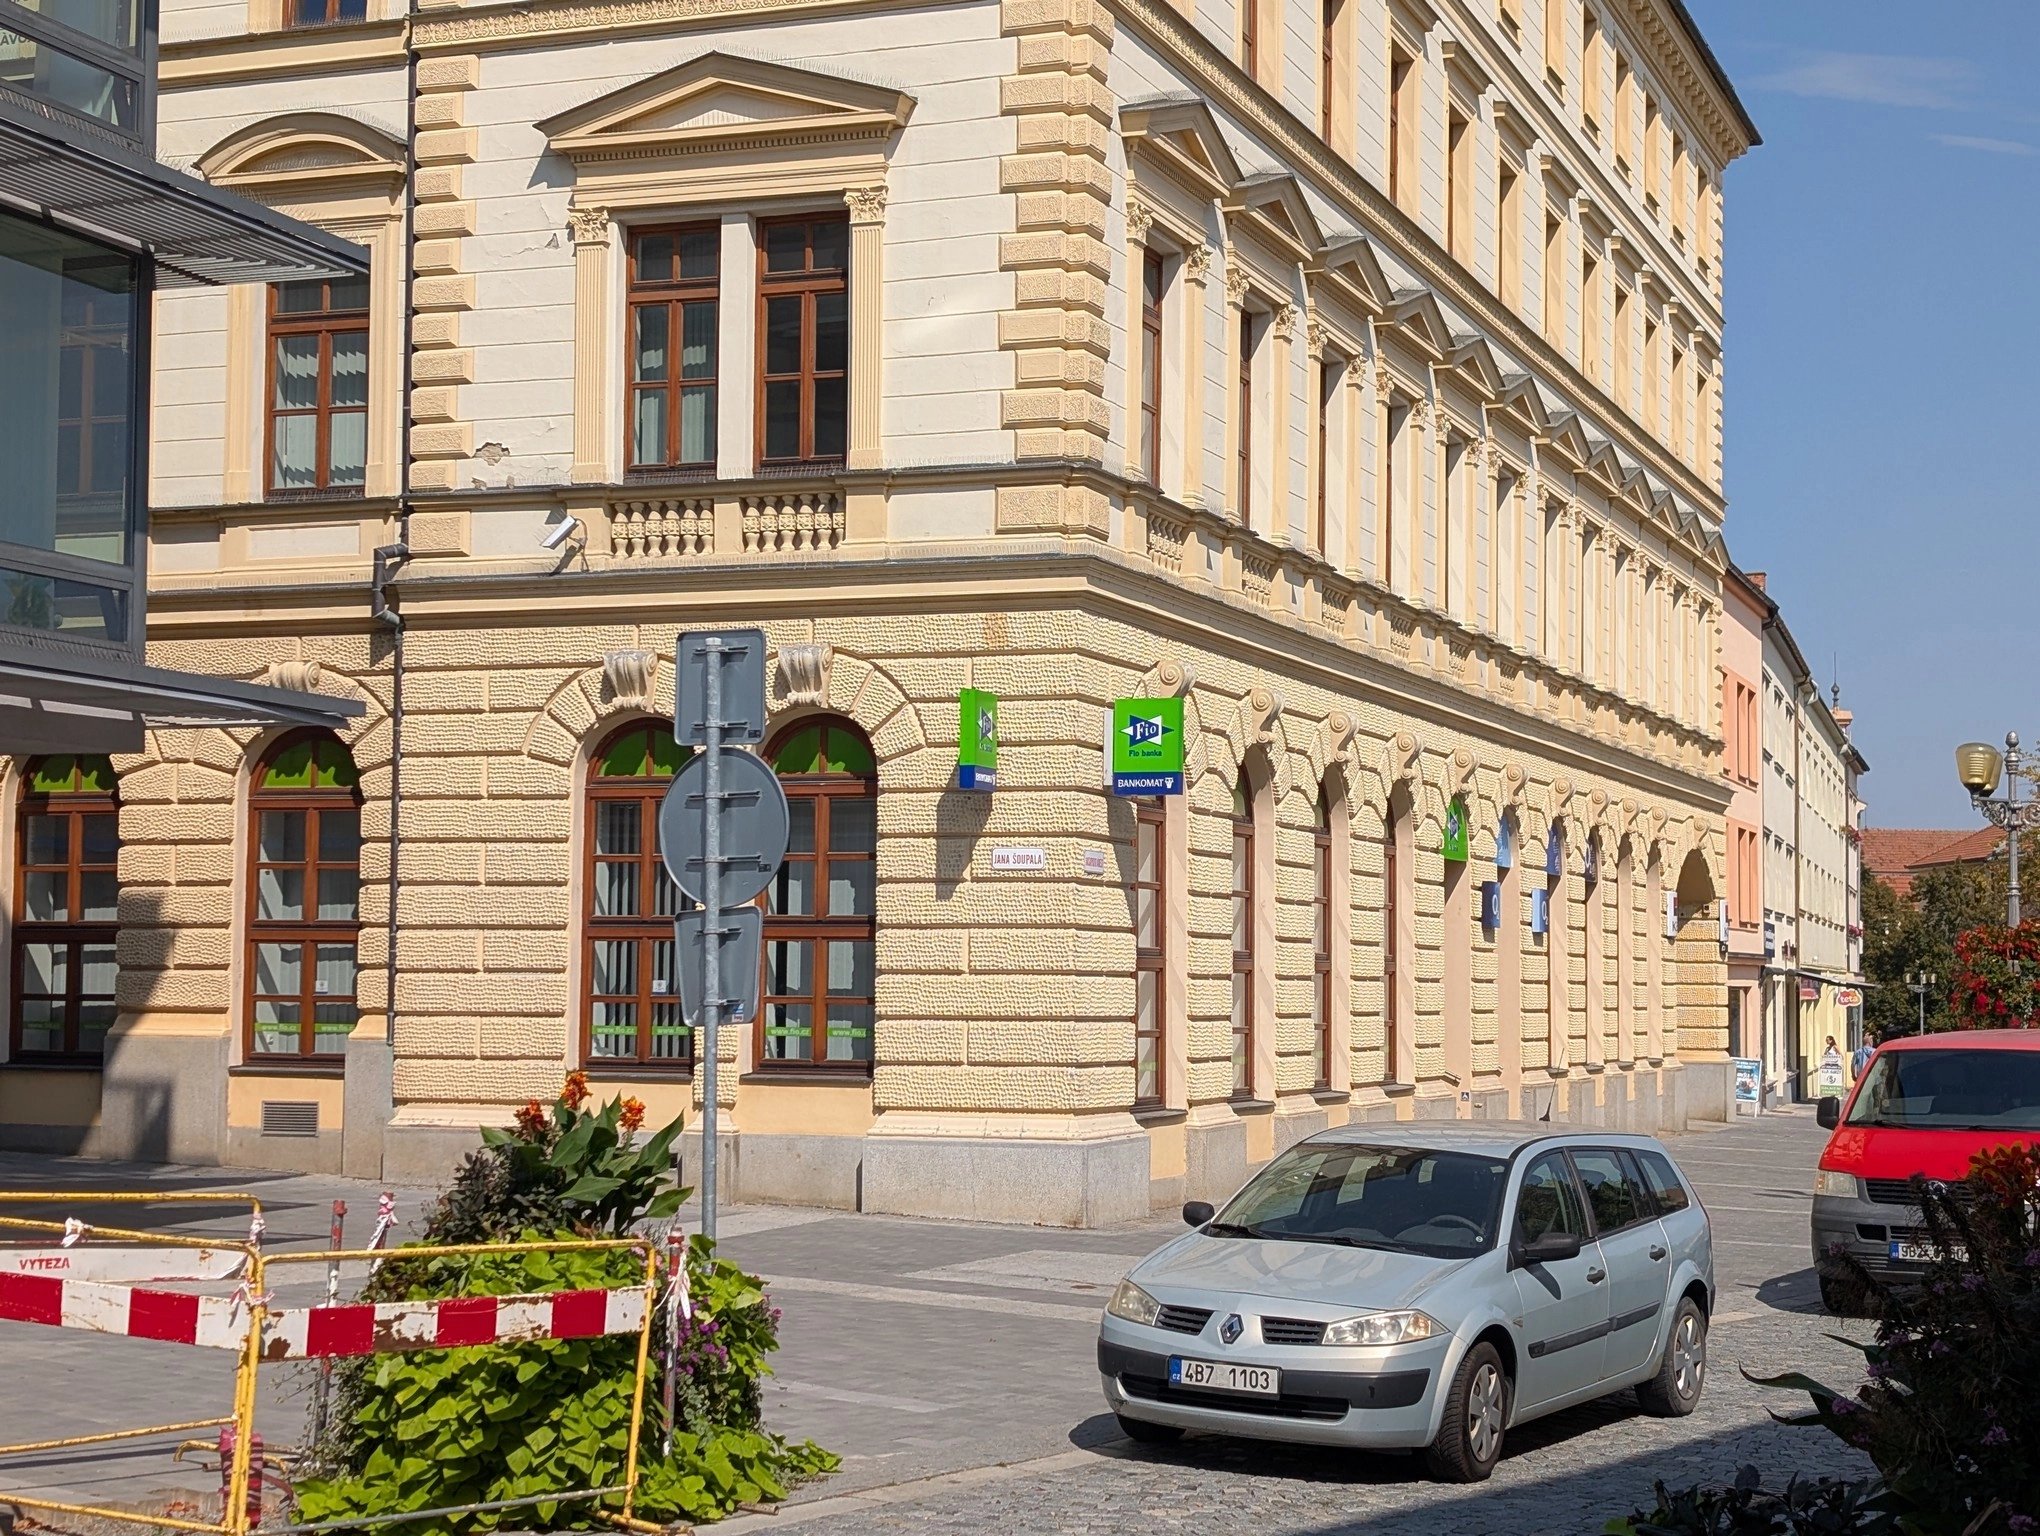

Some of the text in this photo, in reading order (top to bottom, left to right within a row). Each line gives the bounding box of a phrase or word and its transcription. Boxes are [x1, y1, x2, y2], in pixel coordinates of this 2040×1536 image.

[1135, 721, 1157, 740] Fio
[1129, 749, 1162, 757] Fio banka
[1117, 779, 1164, 788] BANKOMAT
[994, 852, 1042, 865] JANA ŠOUPALA
[1840, 993, 1858, 1003] teta
[19, 1257, 70, 1270] VYTEZA
[1185, 1363, 1270, 1390] 4B7 1103
